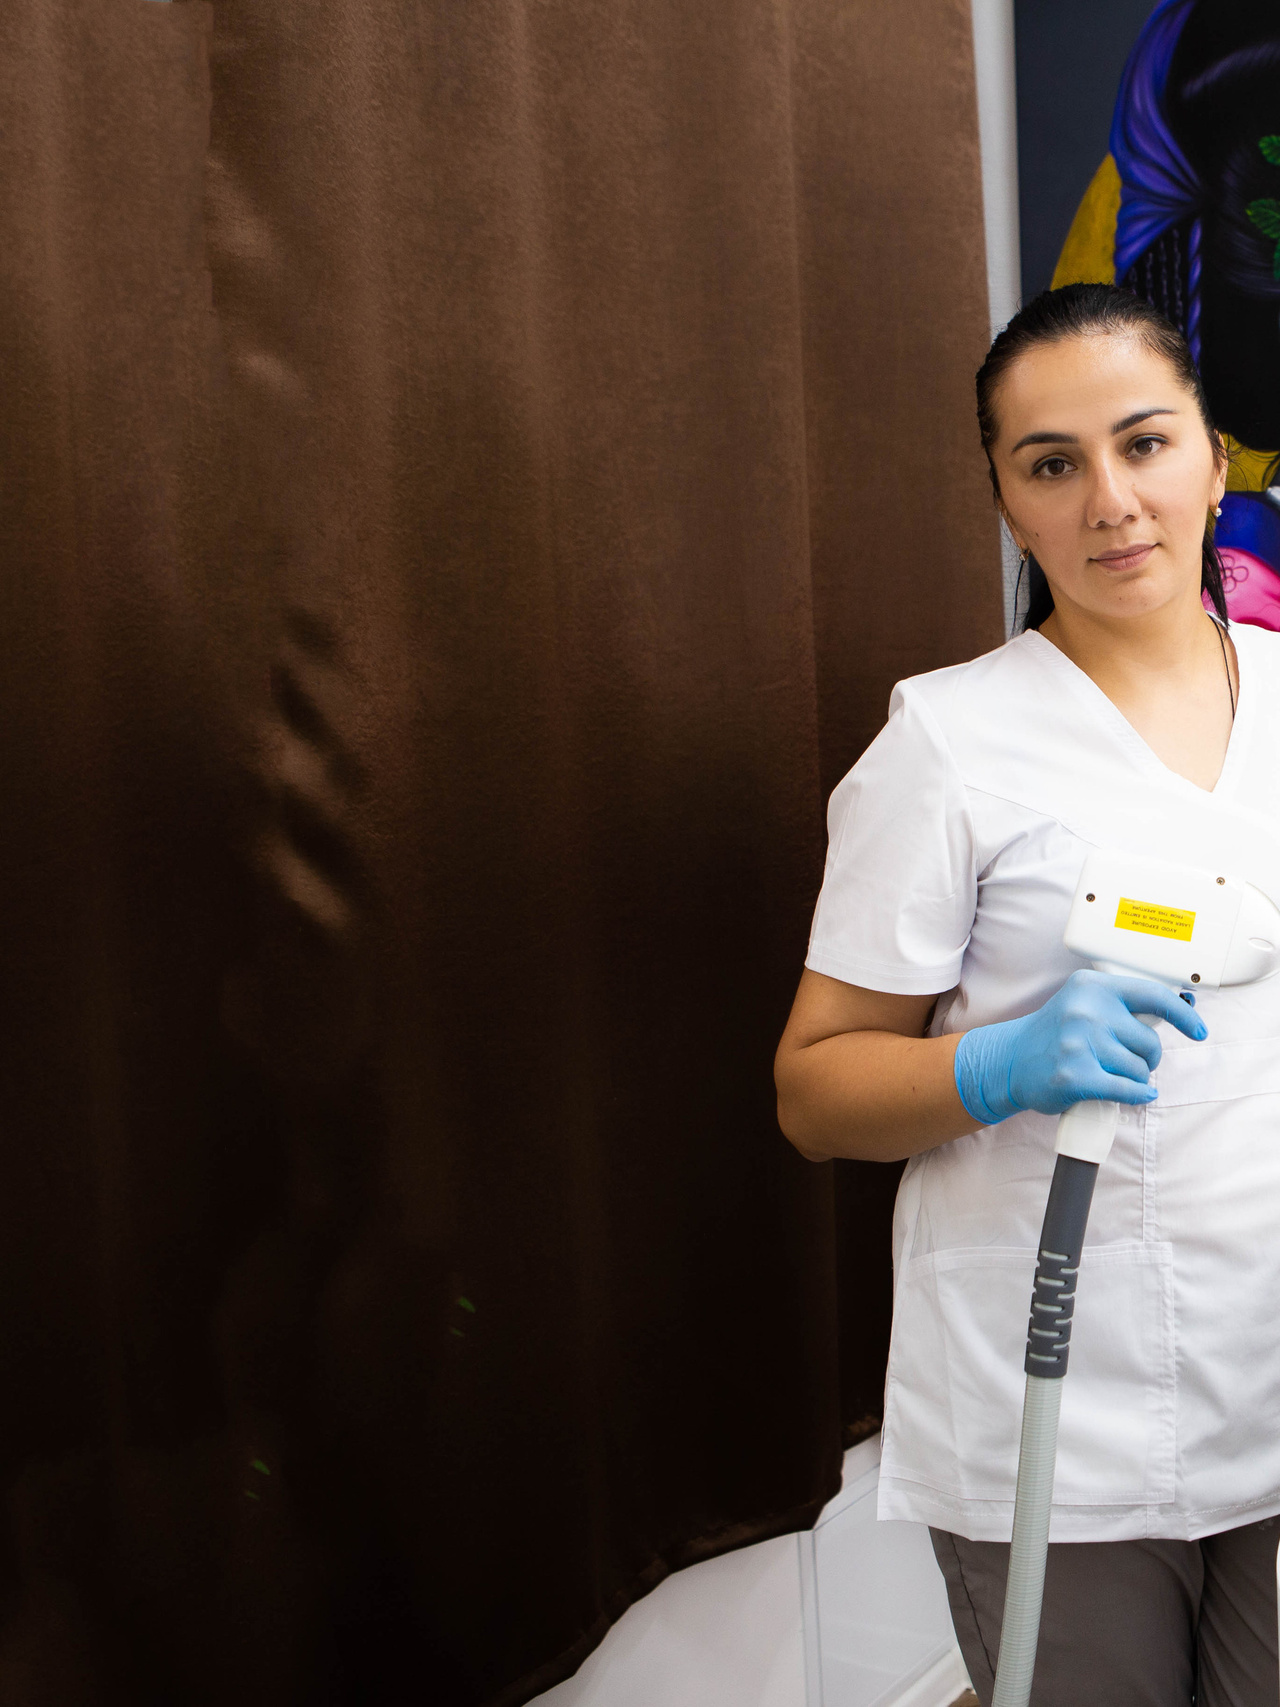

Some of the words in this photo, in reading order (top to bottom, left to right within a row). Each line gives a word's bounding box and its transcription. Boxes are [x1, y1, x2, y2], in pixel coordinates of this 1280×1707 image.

[1132, 905, 1156, 914] APERTURE
[1120, 910, 1141, 919] EMITTED
[1131, 920, 1159, 930] EXPOSURE
[1149, 916, 1174, 925] RADIATION
[1160, 926, 1177, 934] AVOID
